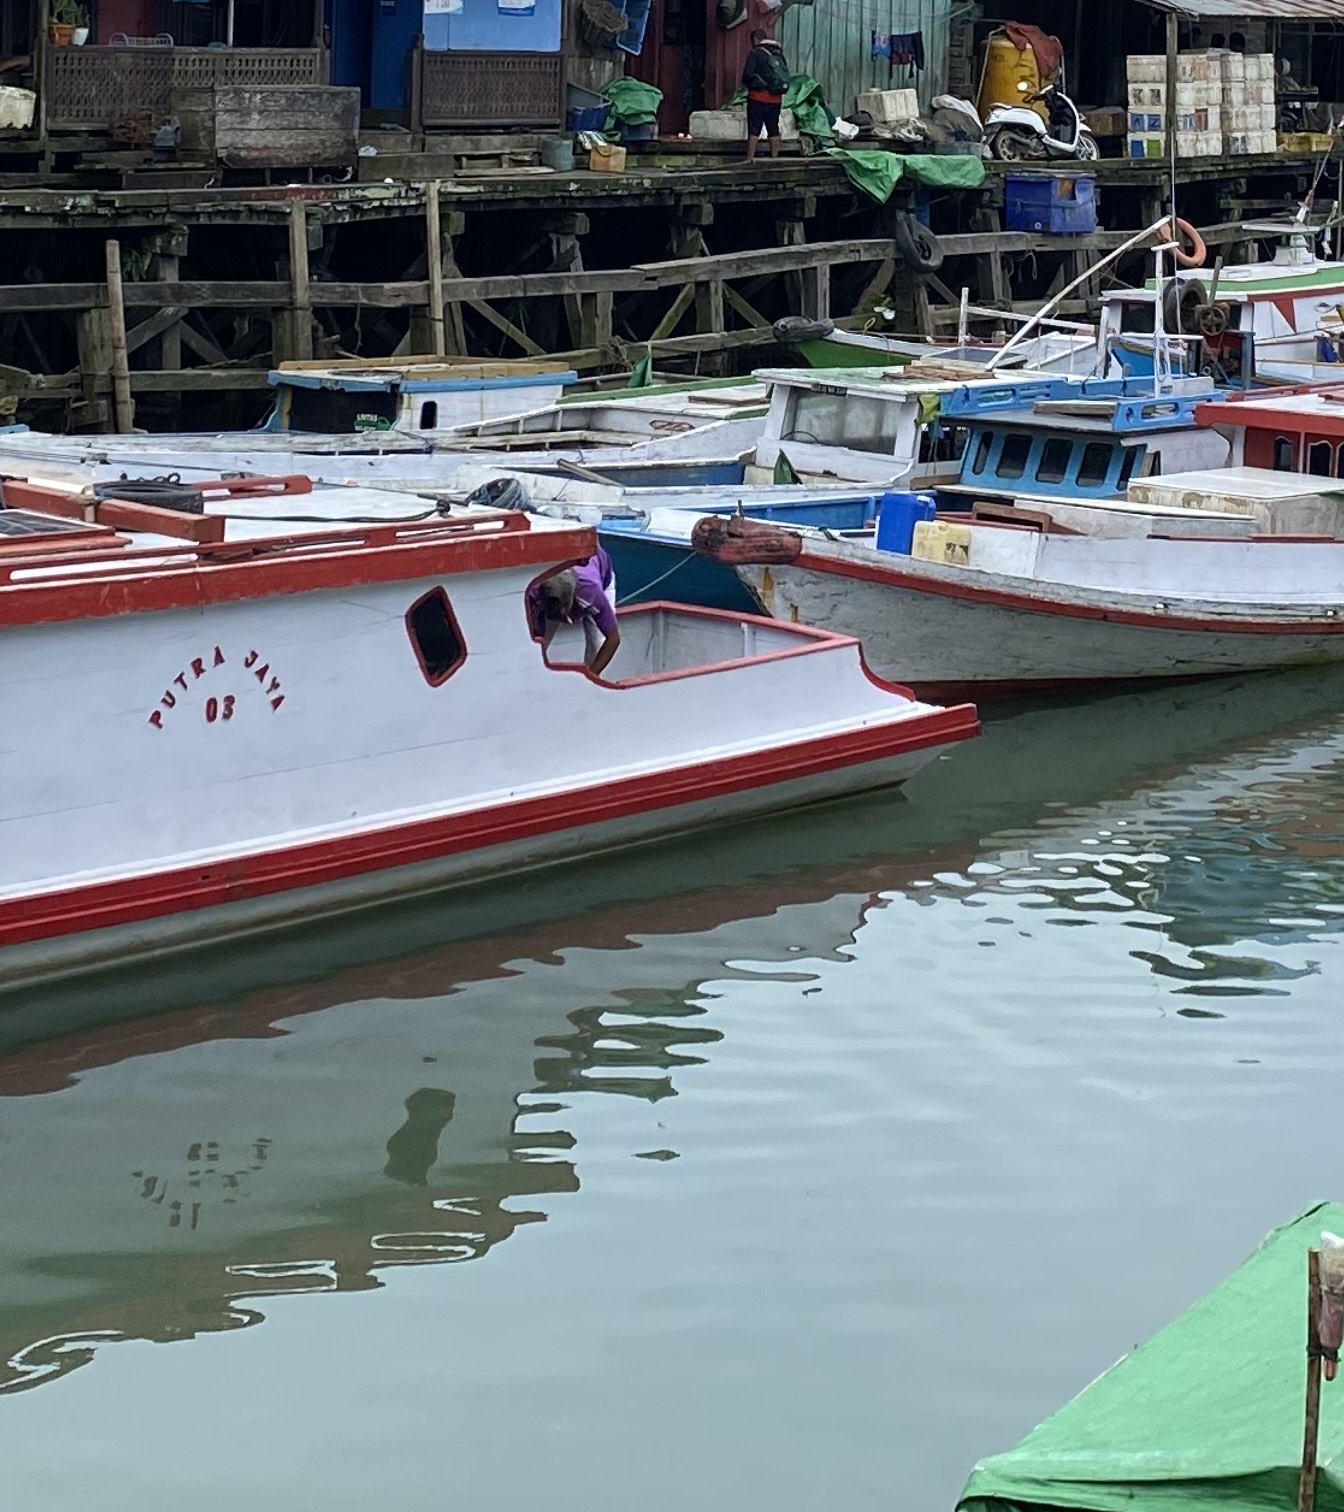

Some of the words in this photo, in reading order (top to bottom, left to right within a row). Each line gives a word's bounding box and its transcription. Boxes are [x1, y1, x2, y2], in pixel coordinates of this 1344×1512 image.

[148, 645, 226, 730] PUTRA
[244, 649, 286, 713] JAYA
[205, 694, 236, 723] 03
